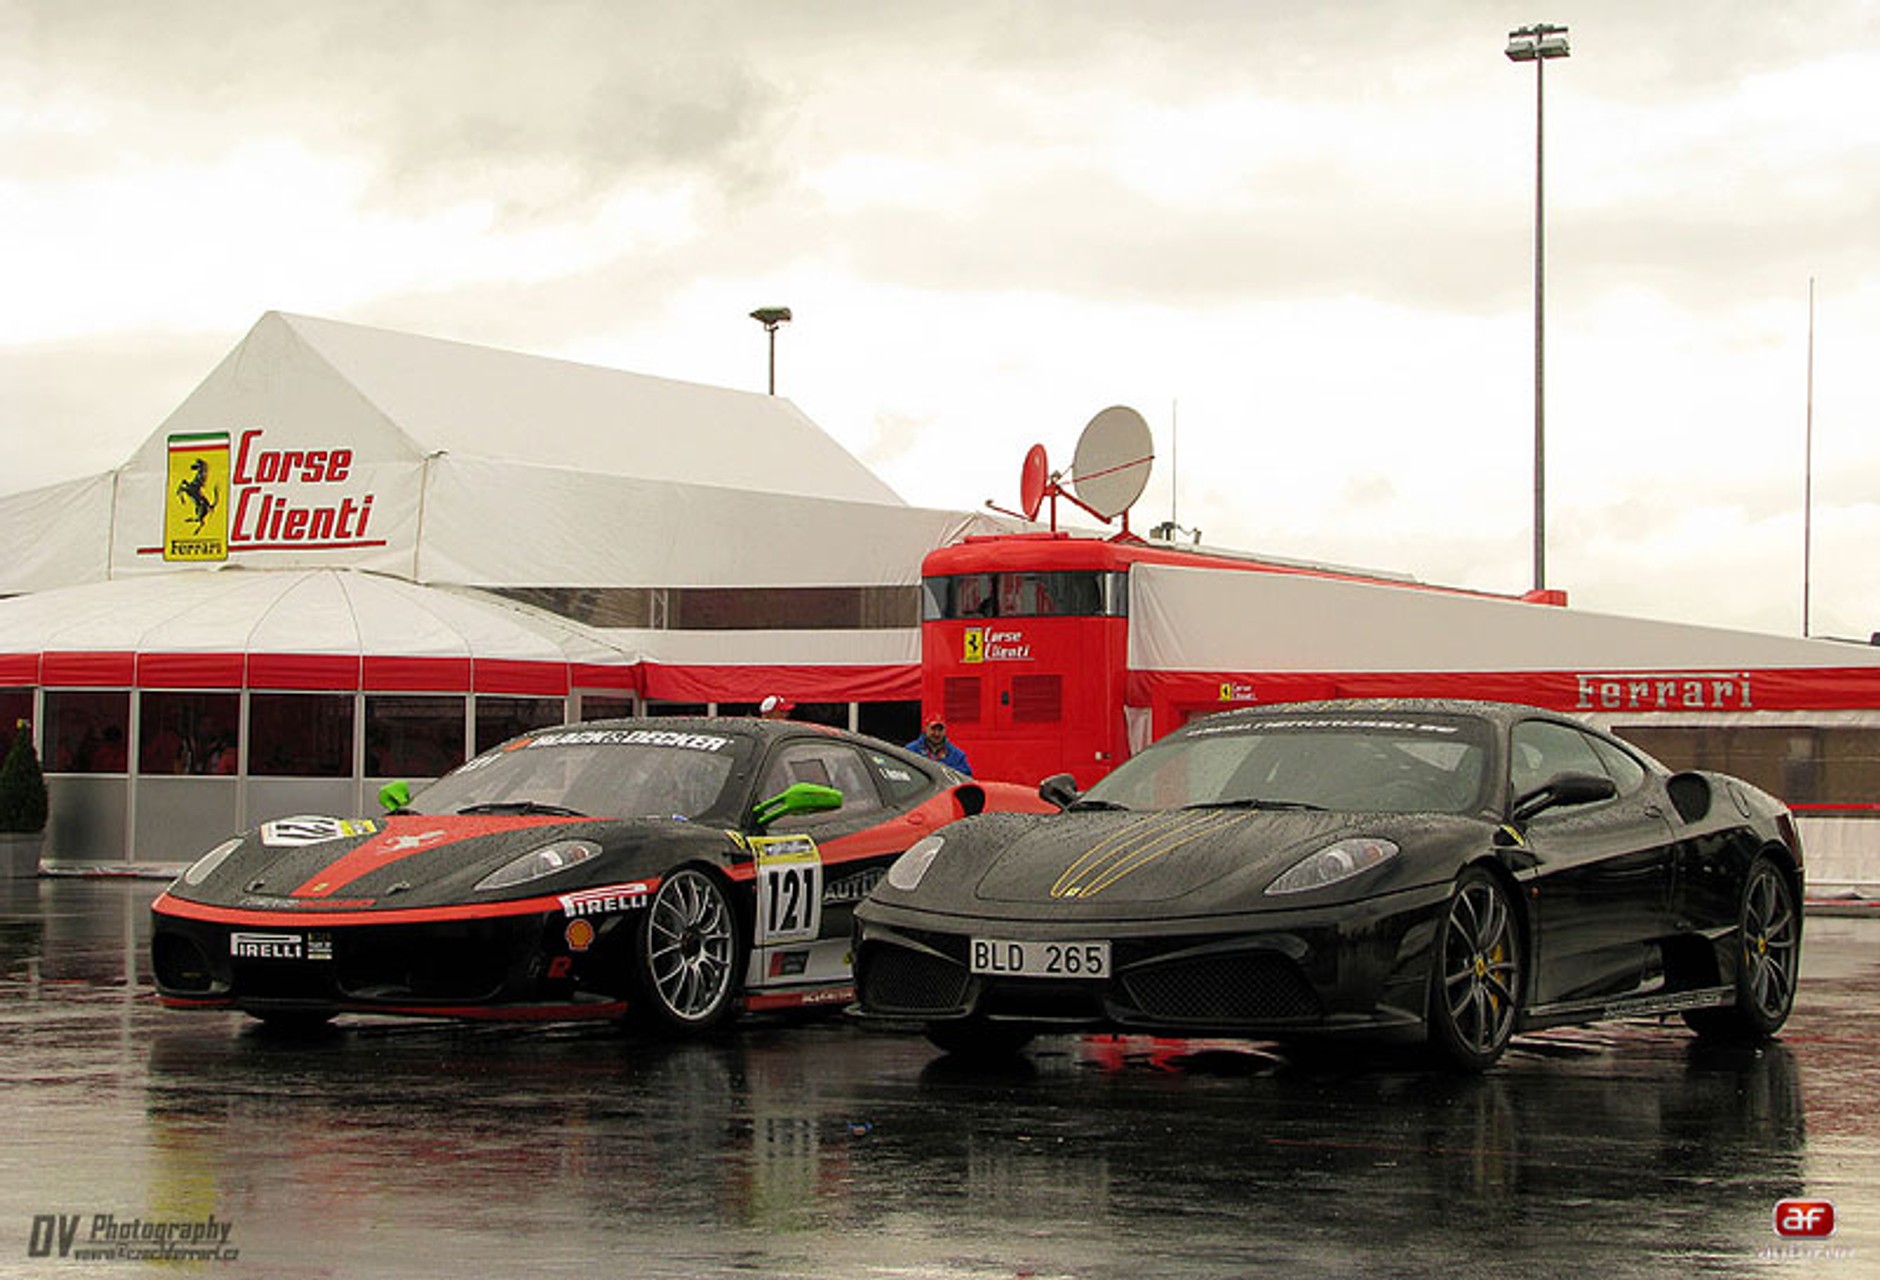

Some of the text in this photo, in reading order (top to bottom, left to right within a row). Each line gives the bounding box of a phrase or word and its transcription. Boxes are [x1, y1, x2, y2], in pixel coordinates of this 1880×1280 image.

[233, 429, 353, 484] Corse
[231, 486, 375, 541] Clienti
[171, 539, 222, 556] Ferrari
[1575, 673, 1752, 708] Ferrari
[558, 882, 649, 918] PIRELLI
[767, 868, 814, 932] 121
[230, 932, 302, 957] PIRELLI
[975, 942, 1103, 974] BLD 265
